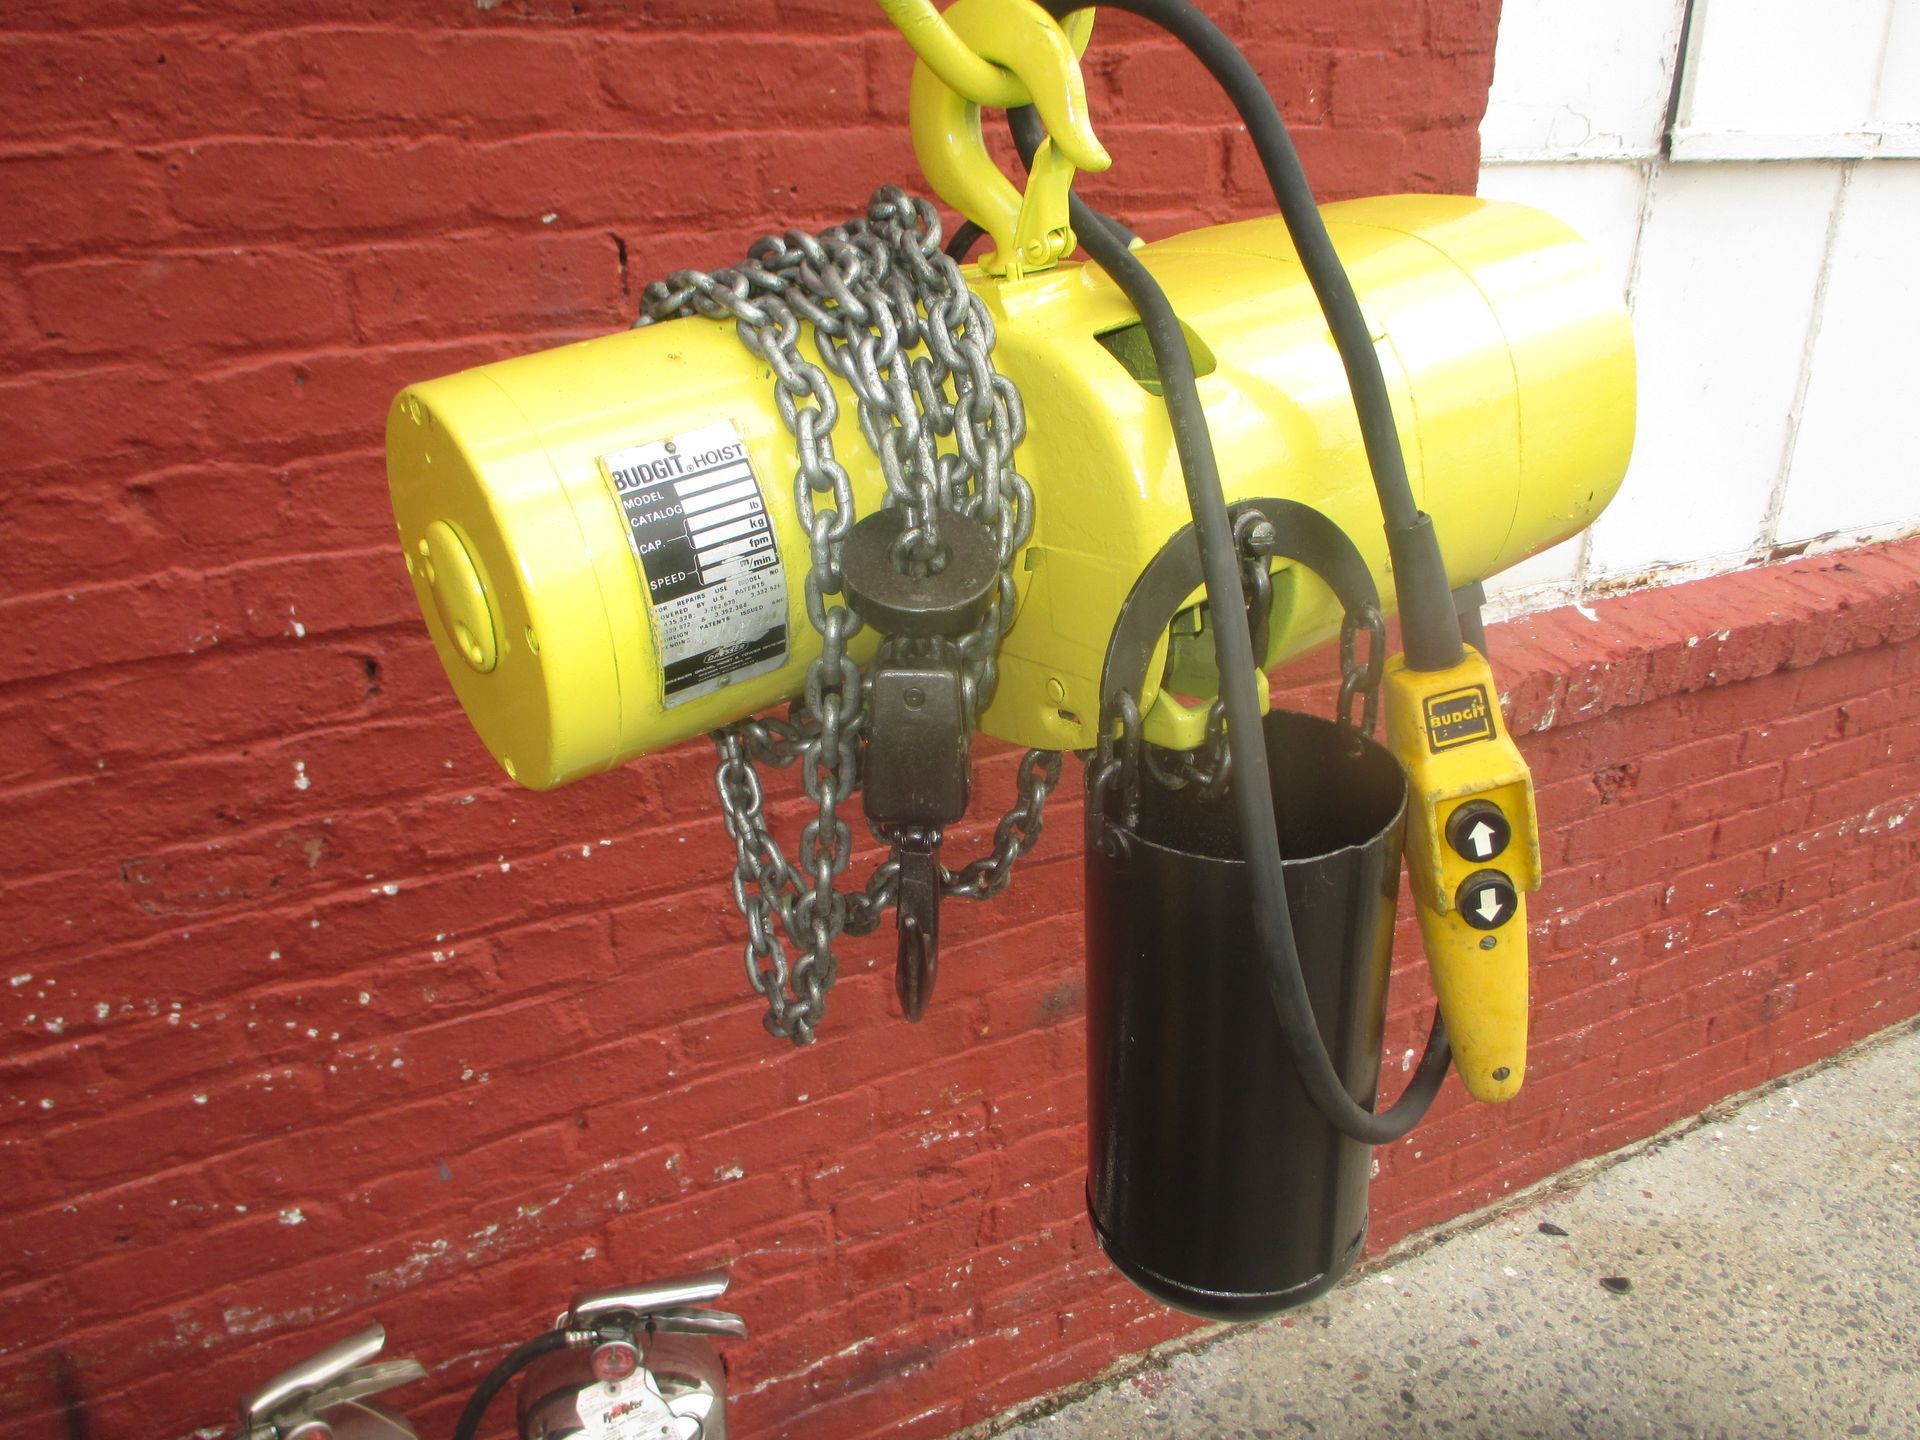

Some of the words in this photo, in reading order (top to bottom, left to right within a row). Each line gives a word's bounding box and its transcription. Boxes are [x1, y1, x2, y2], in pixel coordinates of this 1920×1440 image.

[612, 454, 684, 491] BUDGIT
[693, 443, 744, 468] HOIST
[623, 491, 665, 510] MODEL
[749, 501, 760, 510] lb
[630, 504, 683, 528] CATALOG
[749, 517, 765, 529] kg
[639, 539, 666, 554] CAP.
[749, 535, 769, 548] fpm
[650, 571, 687, 590] SPEED
[655, 605, 668, 613] OR
[677, 593, 706, 607] REPAIRS
[714, 586, 728, 594] USE
[660, 607, 689, 620] OVERED
[696, 601, 705, 609] BY
[735, 581, 765, 595] PATENTS
[699, 616, 731, 630] PATENTS
[740, 605, 764, 617] ISSUED
